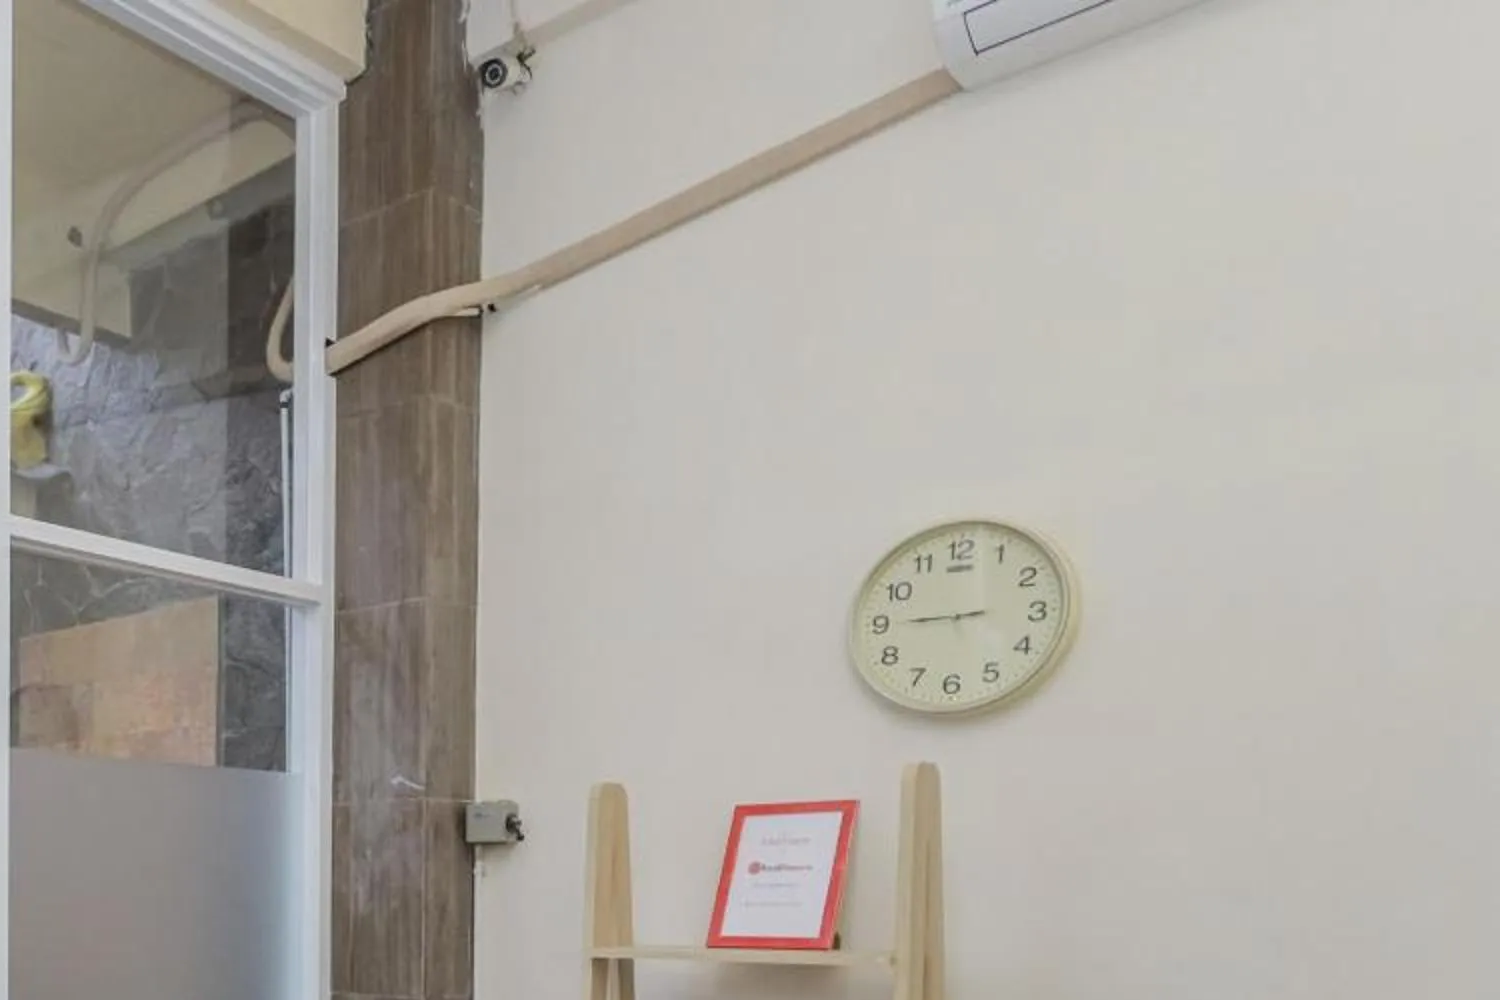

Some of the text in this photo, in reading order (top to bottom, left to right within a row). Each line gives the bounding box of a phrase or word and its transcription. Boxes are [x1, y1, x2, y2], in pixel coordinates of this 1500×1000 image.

[949, 539, 975, 560] 12
[996, 545, 1005, 564] 1
[914, 554, 933, 573] 11
[1018, 567, 1038, 587] 2
[887, 582, 912, 600] 10
[1028, 601, 1047, 621] 3
[872, 615, 889, 634] 9
[1013, 635, 1032, 655] 4
[881, 646, 899, 665] 8
[910, 668, 926, 687] 7
[982, 662, 999, 683] 5
[943, 674, 961, 694] 6
